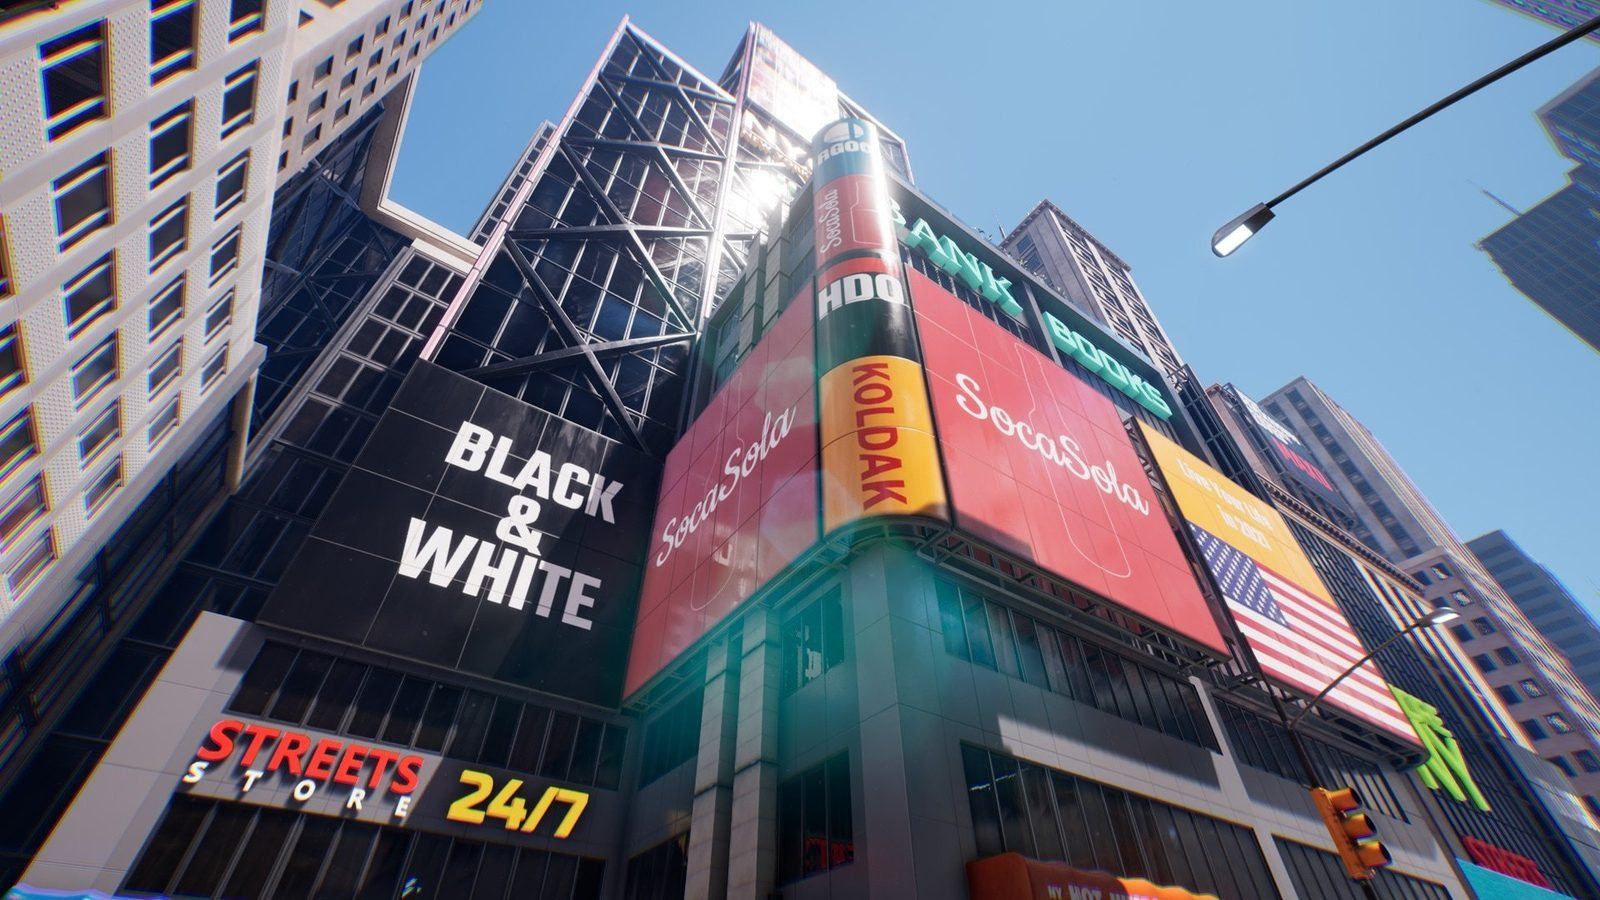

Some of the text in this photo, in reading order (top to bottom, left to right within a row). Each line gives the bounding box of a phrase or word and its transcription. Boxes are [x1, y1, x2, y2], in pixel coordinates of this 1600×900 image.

[1042, 310, 1173, 421] BOOKS
[444, 420, 624, 524] BLACK
[655, 405, 798, 568] SocaSola
[852, 362, 908, 511] KOLDAK
[955, 372, 1150, 517] SocaSola
[398, 516, 602, 632] WHITE
[495, 494, 543, 557] &
[183, 761, 412, 818] STORE
[197, 719, 424, 795] STREETS
[447, 769, 590, 839] 24/7
